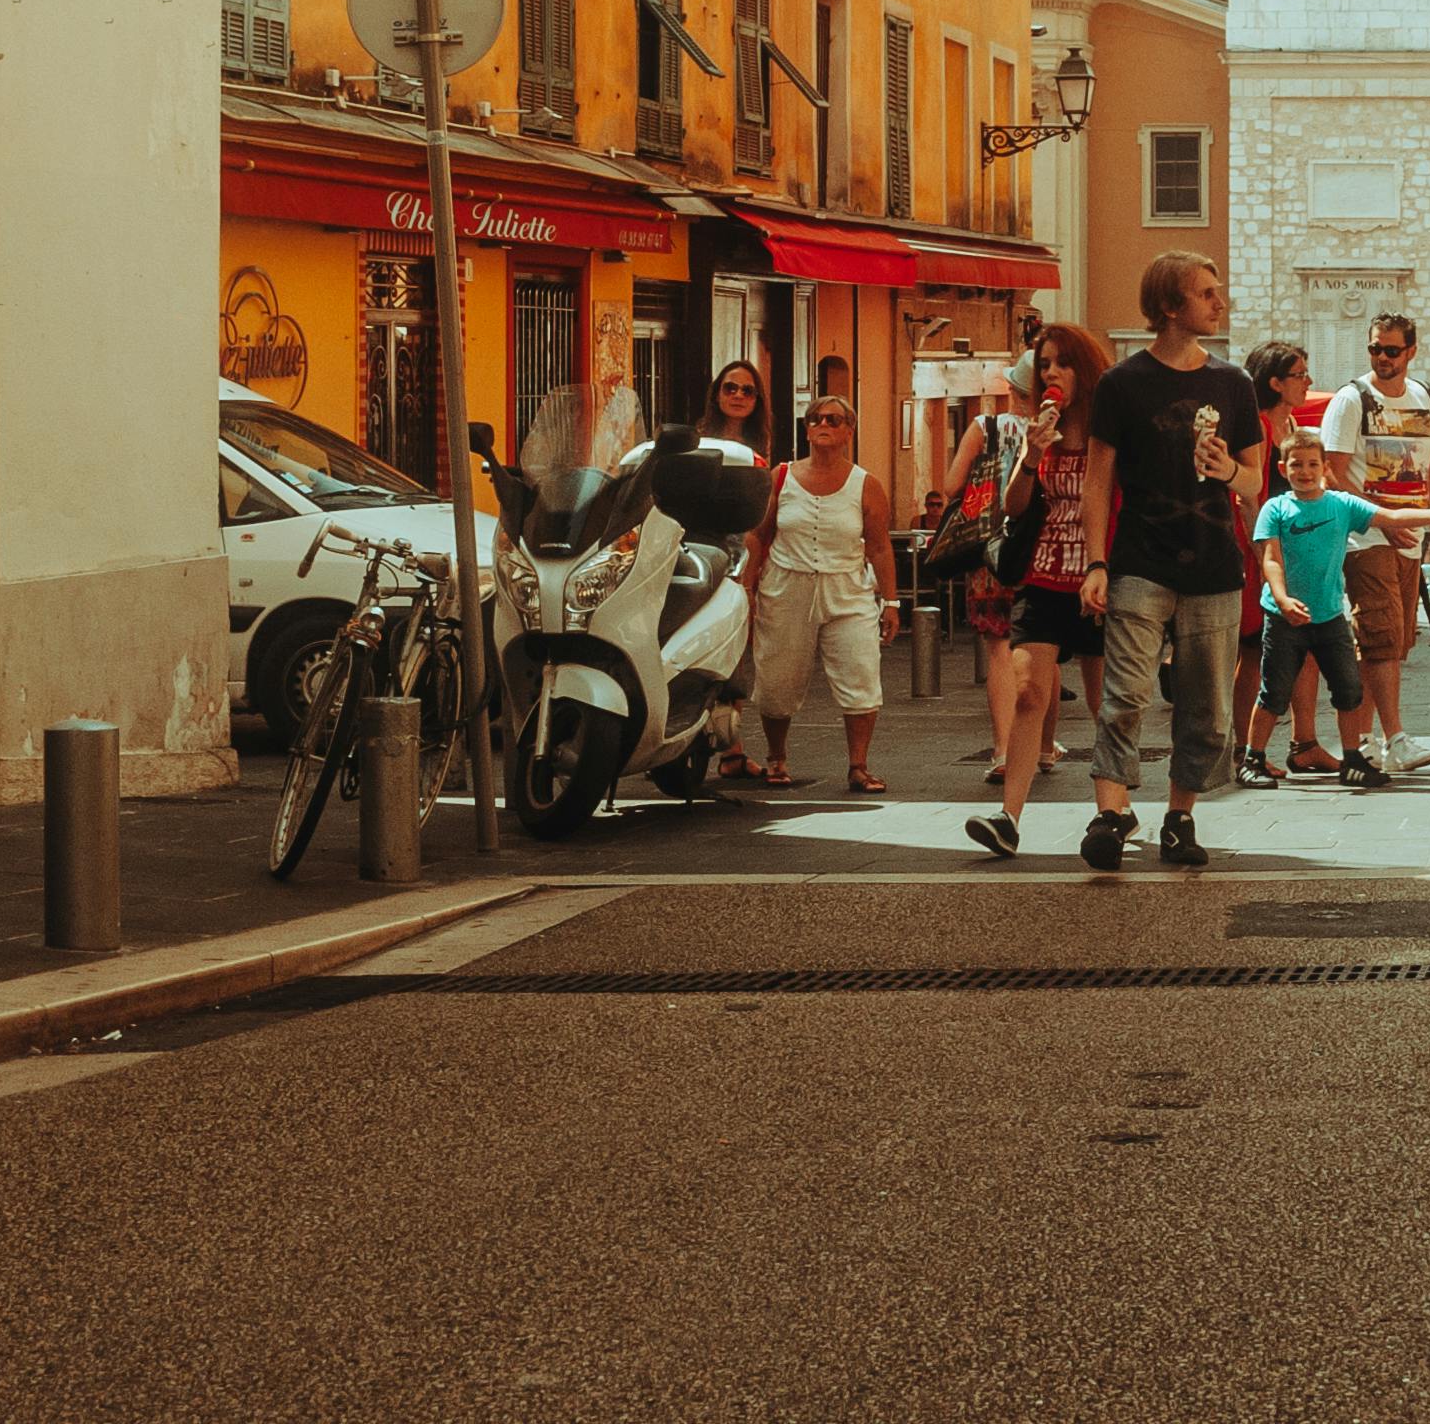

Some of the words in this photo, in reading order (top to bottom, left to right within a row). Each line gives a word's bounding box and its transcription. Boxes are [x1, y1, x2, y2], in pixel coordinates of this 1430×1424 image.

[464, 201, 557, 244] Juliette
[1313, 279, 1320, 290] A
[1325, 279, 1349, 290] NOS
